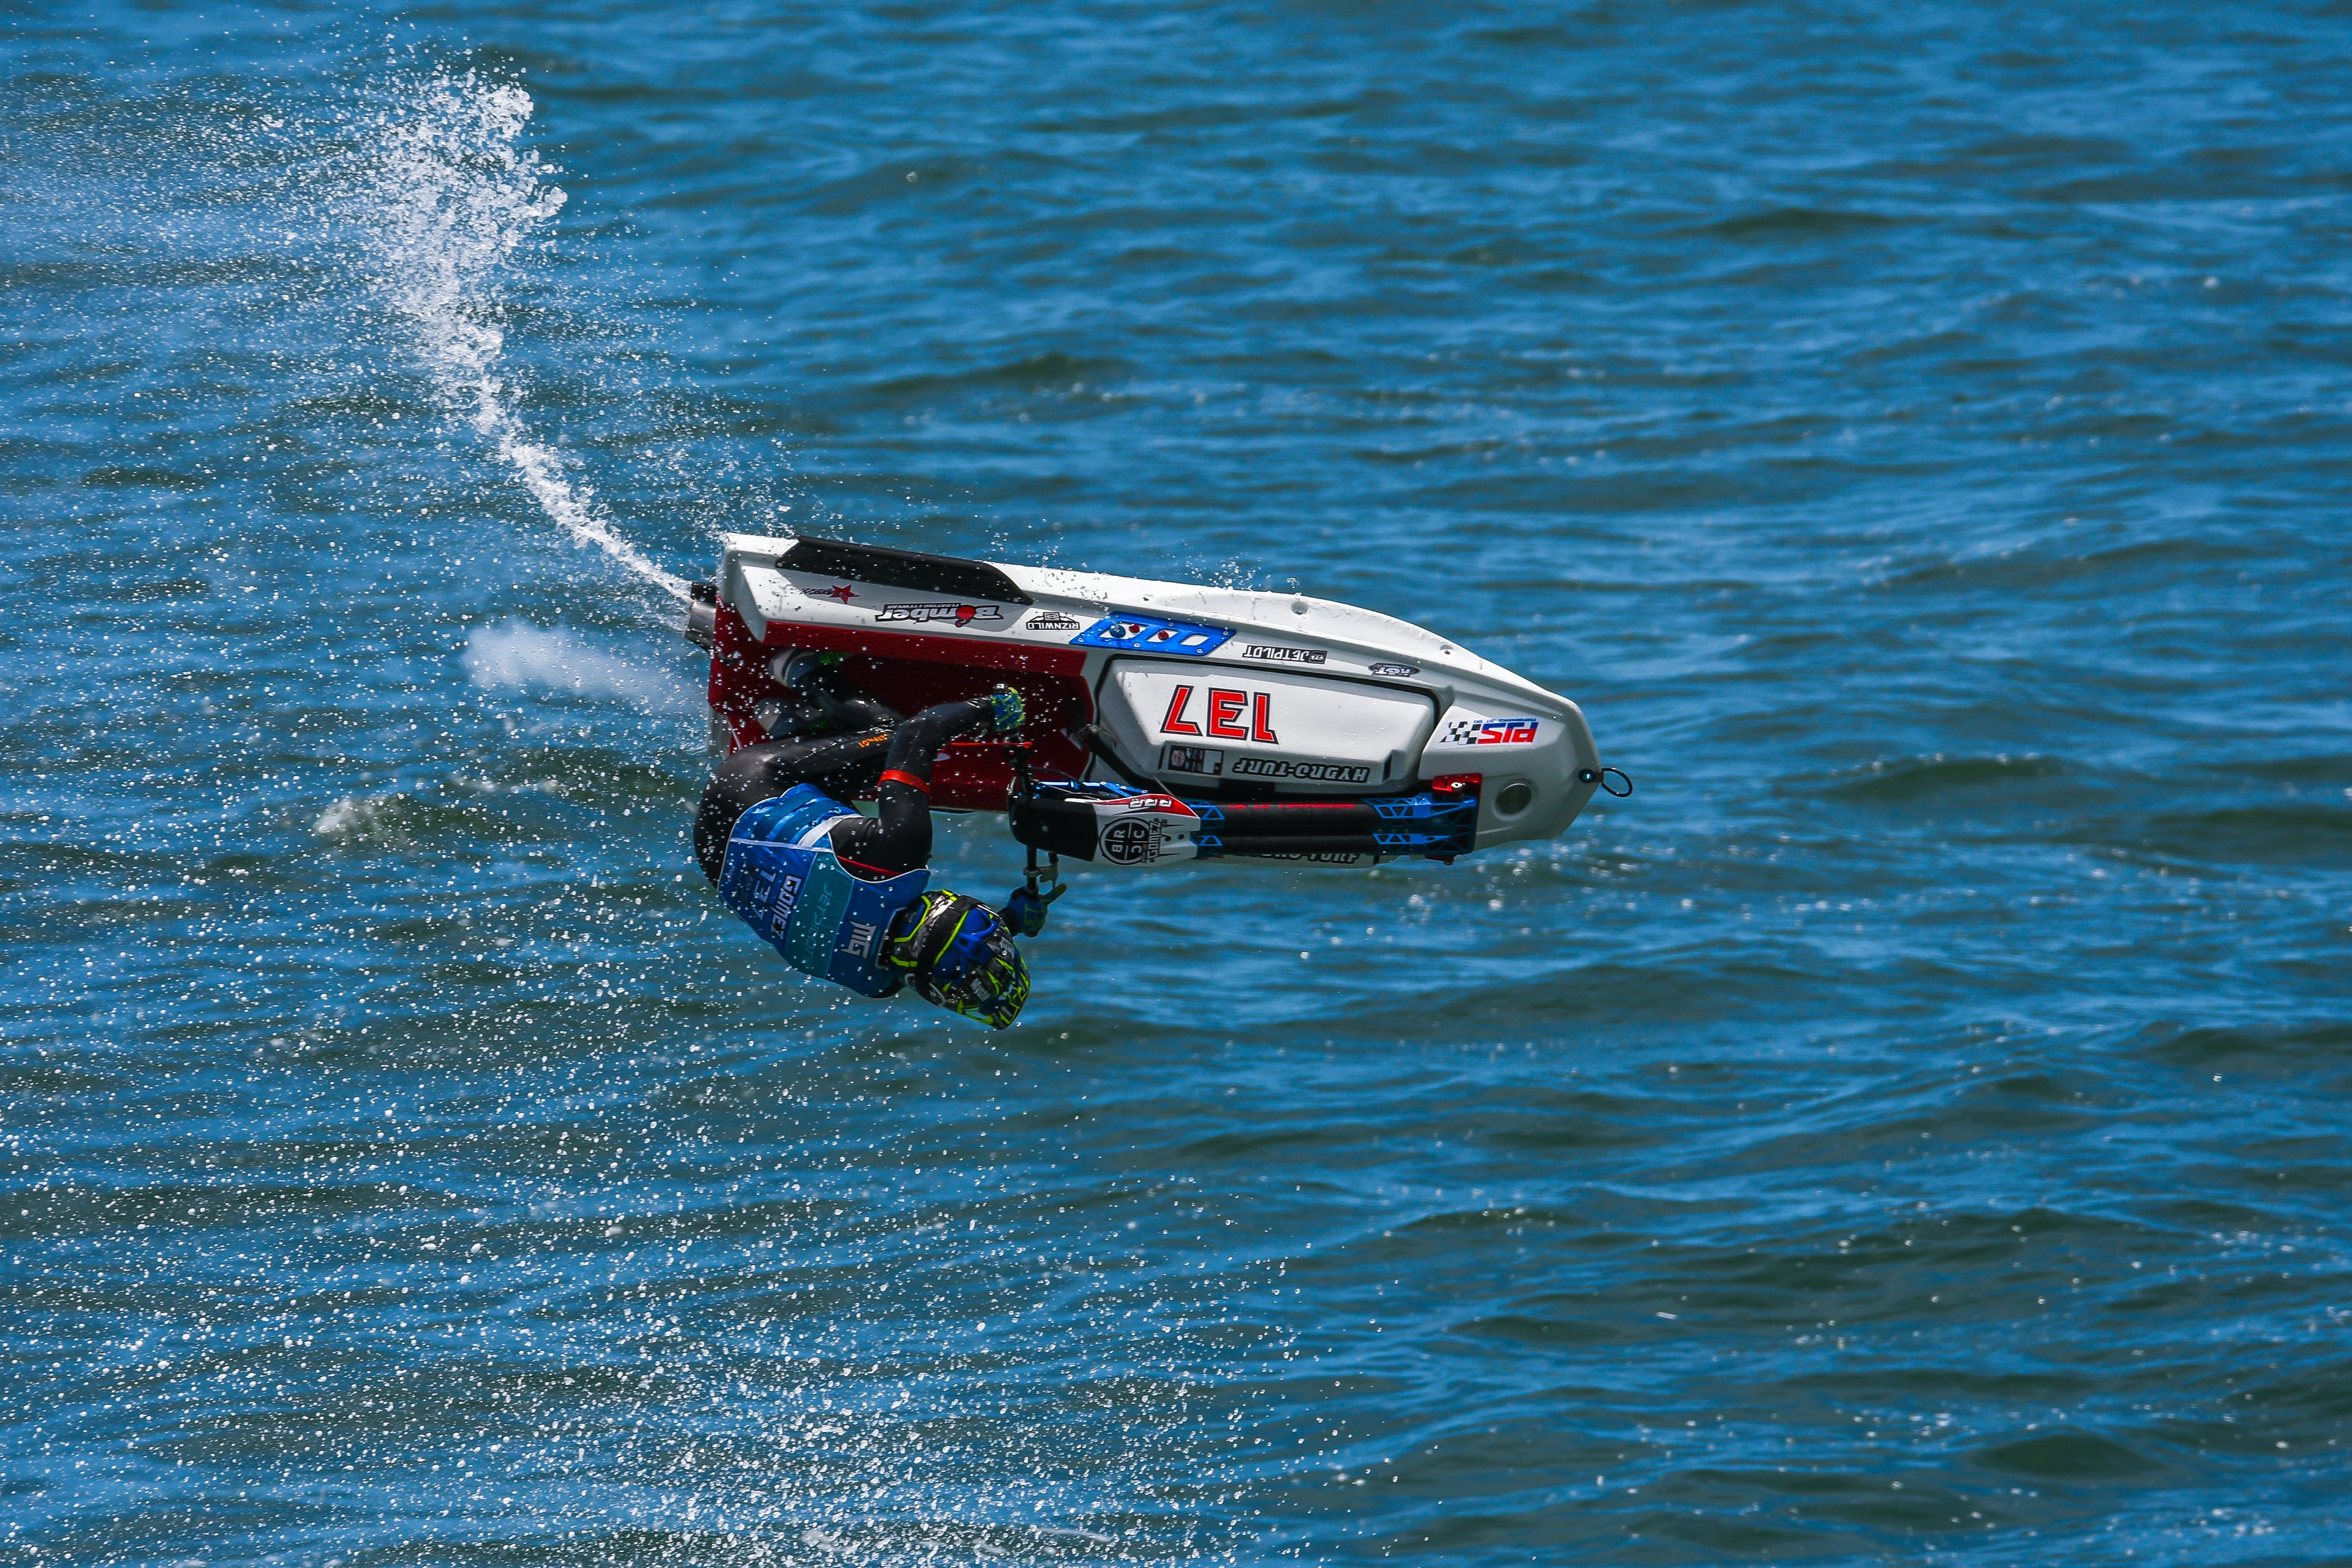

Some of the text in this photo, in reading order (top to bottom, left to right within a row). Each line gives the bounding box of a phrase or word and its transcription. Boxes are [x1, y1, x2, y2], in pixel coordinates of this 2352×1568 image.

[876, 604, 1003, 623] Bomber
[1244, 646, 1310, 662] JETPILOT
[1159, 684, 1280, 745] 137
[1477, 722, 1539, 744] PJS
[1235, 759, 1368, 782] HYDRO-TURF
[1147, 819, 1162, 859] GOMEZ
[752, 870, 777, 920] 137
[770, 875, 802, 941] GOMEZ
